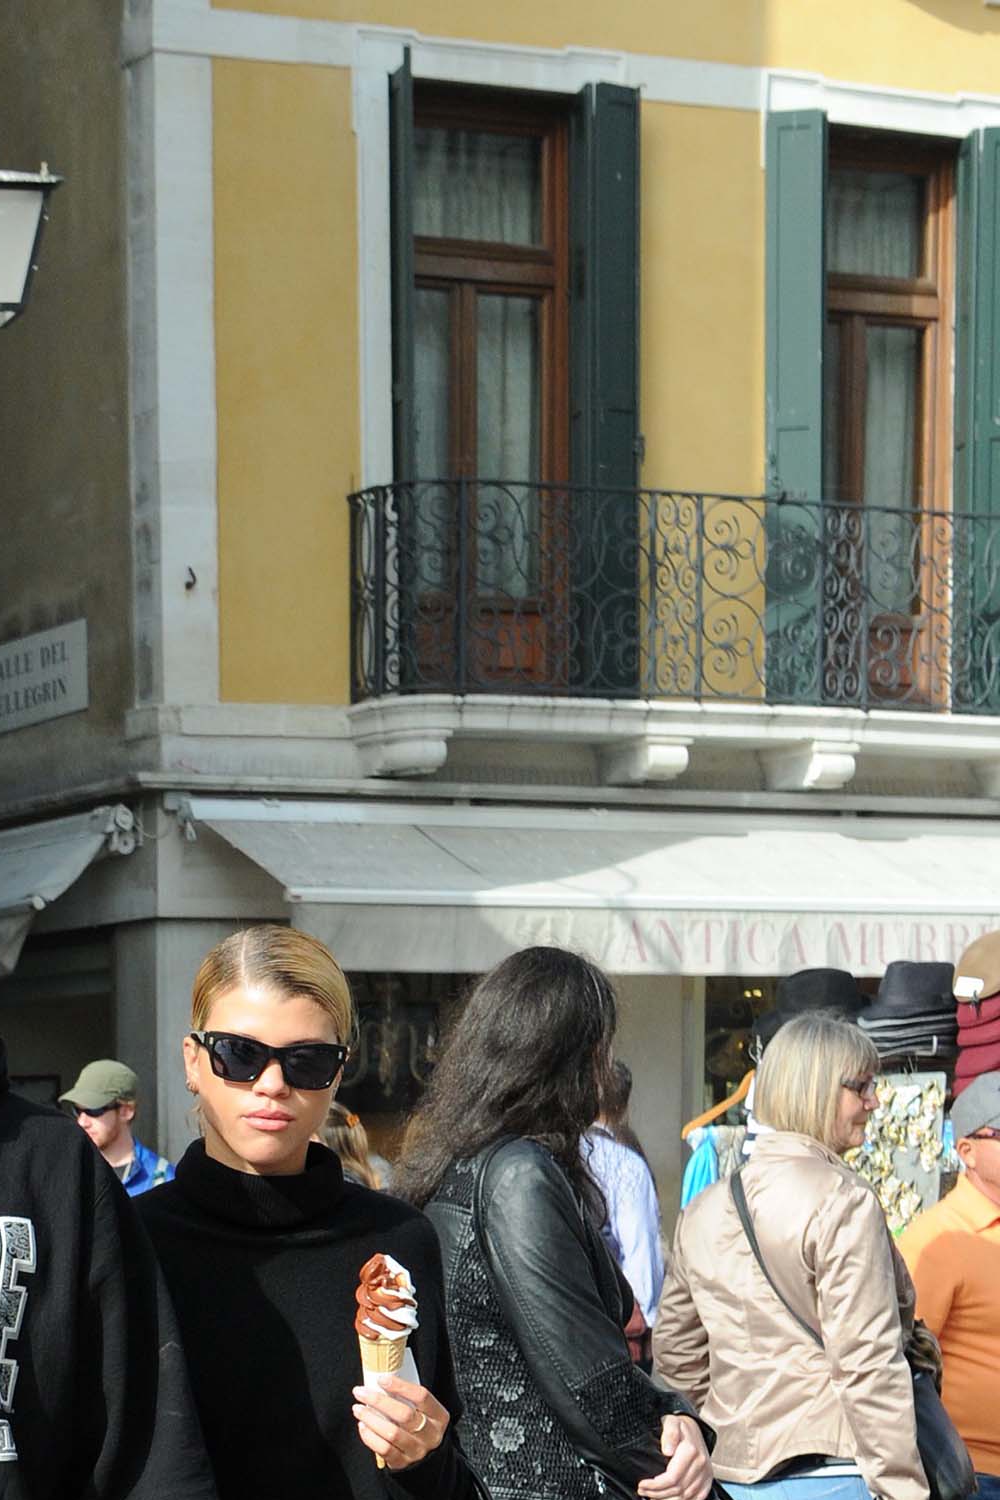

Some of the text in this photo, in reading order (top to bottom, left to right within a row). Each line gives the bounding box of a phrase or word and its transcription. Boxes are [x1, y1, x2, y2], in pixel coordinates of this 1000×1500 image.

[40, 640, 70, 670] DEL
[621, 917, 989, 966] ANTICA MURR
